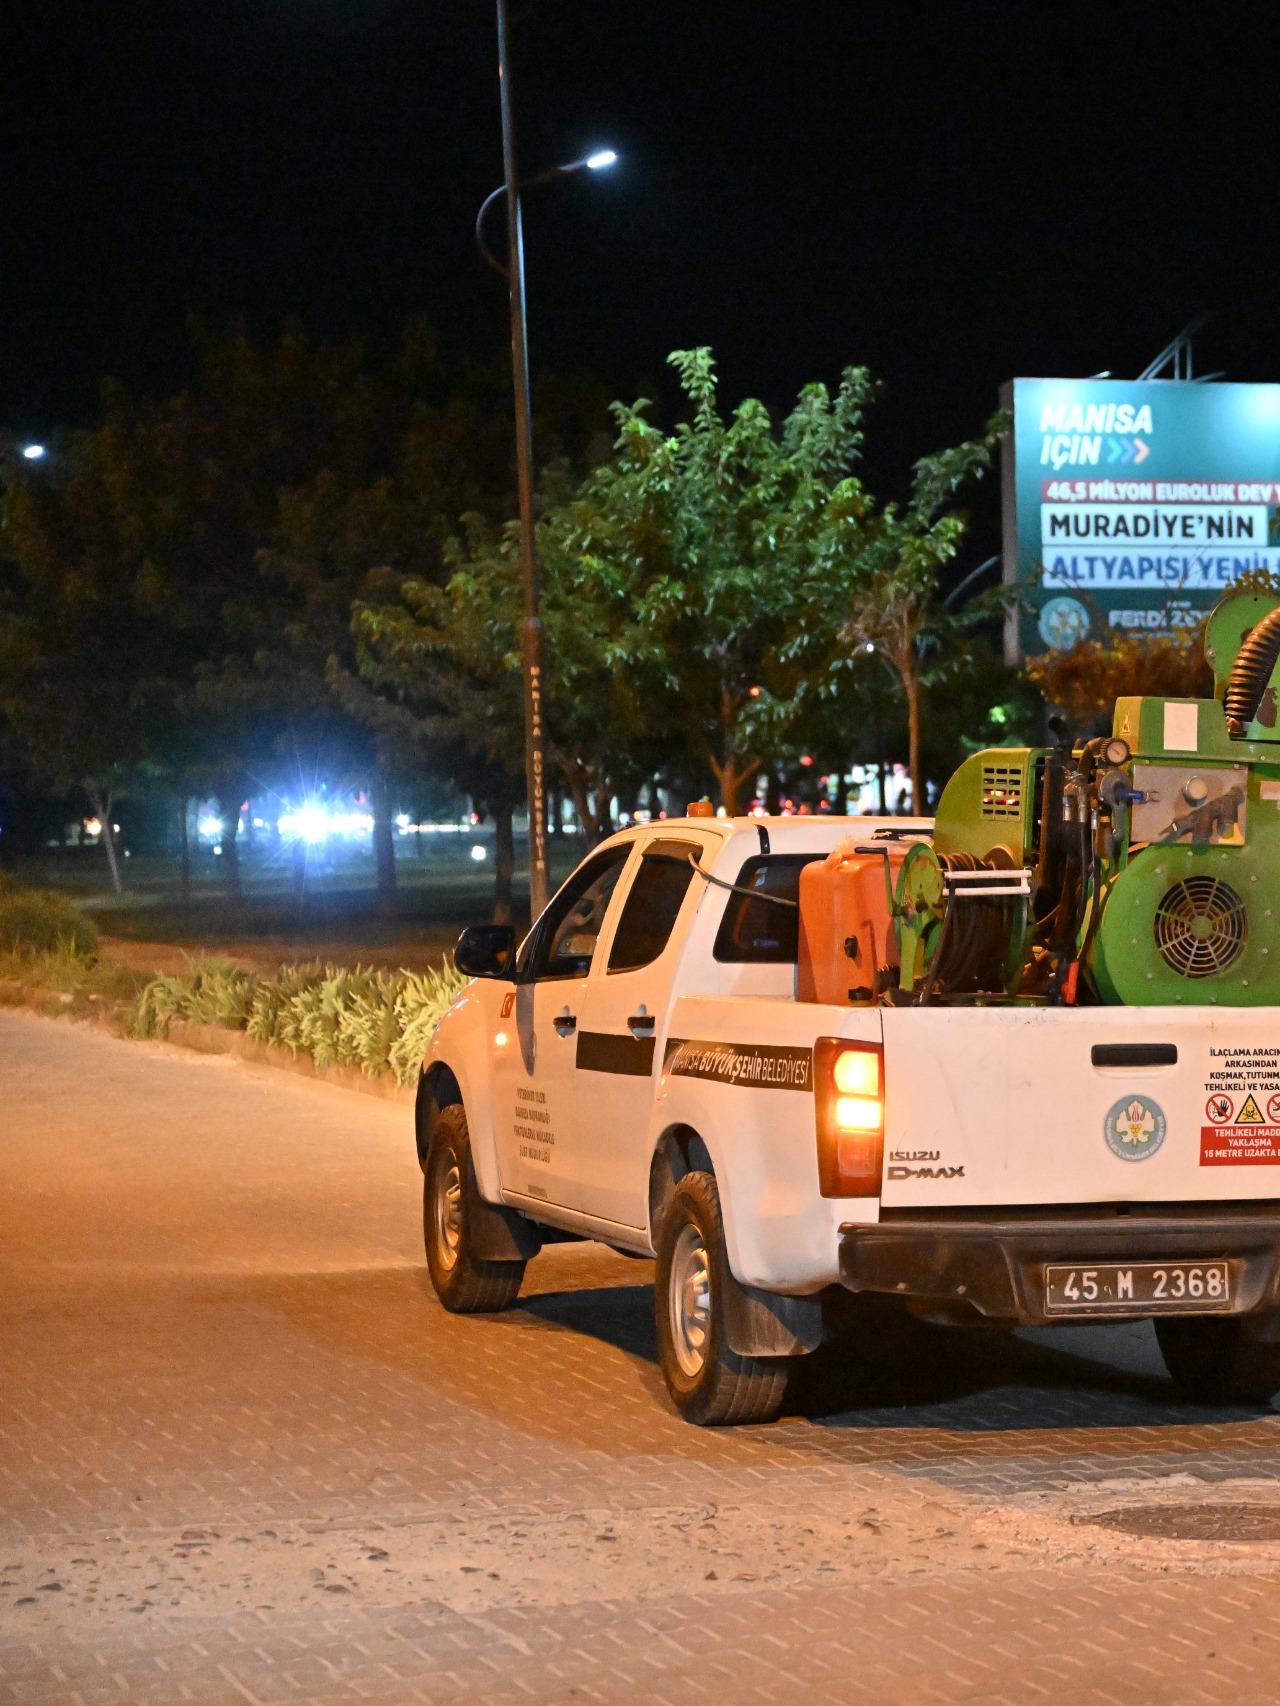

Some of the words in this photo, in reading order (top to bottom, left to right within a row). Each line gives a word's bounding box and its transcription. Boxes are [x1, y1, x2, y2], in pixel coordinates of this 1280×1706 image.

[1040, 434, 1102, 471] İÇİN
[1047, 481, 1087, 502] 46,5
[1089, 479, 1153, 500] MİLYON
[1155, 482, 1235, 501] EUROLUK
[1237, 483, 1272, 501] DEV
[1051, 555, 1189, 581] ALTYAPISI
[1210, 1047, 1251, 1058] İLAÇLAMA
[699, 1047, 762, 1083] BÜYÜKŞEHİR
[762, 1054, 810, 1084] BELEDİYESİ
[1224, 1059, 1278, 1068] ARKASINDAN
[1204, 1081, 1246, 1091] TEHLİKELİ
[1247, 1083, 1258, 1091] VE
[1214, 1126, 1257, 1137] TEHLİKELİ
[1228, 1138, 1272, 1148] YAKLAŞMA
[889, 1150, 941, 1161] ISUZU
[1204, 1149, 1214, 1158] 15
[1215, 1149, 1243, 1158] METRE
[1244, 1148, 1277, 1157] UZAKTA
[887, 1165, 966, 1181] D-MAX
[1063, 1271, 1099, 1300] 45
[1116, 1270, 1134, 1299] M
[1152, 1268, 1222, 1298] 2368
